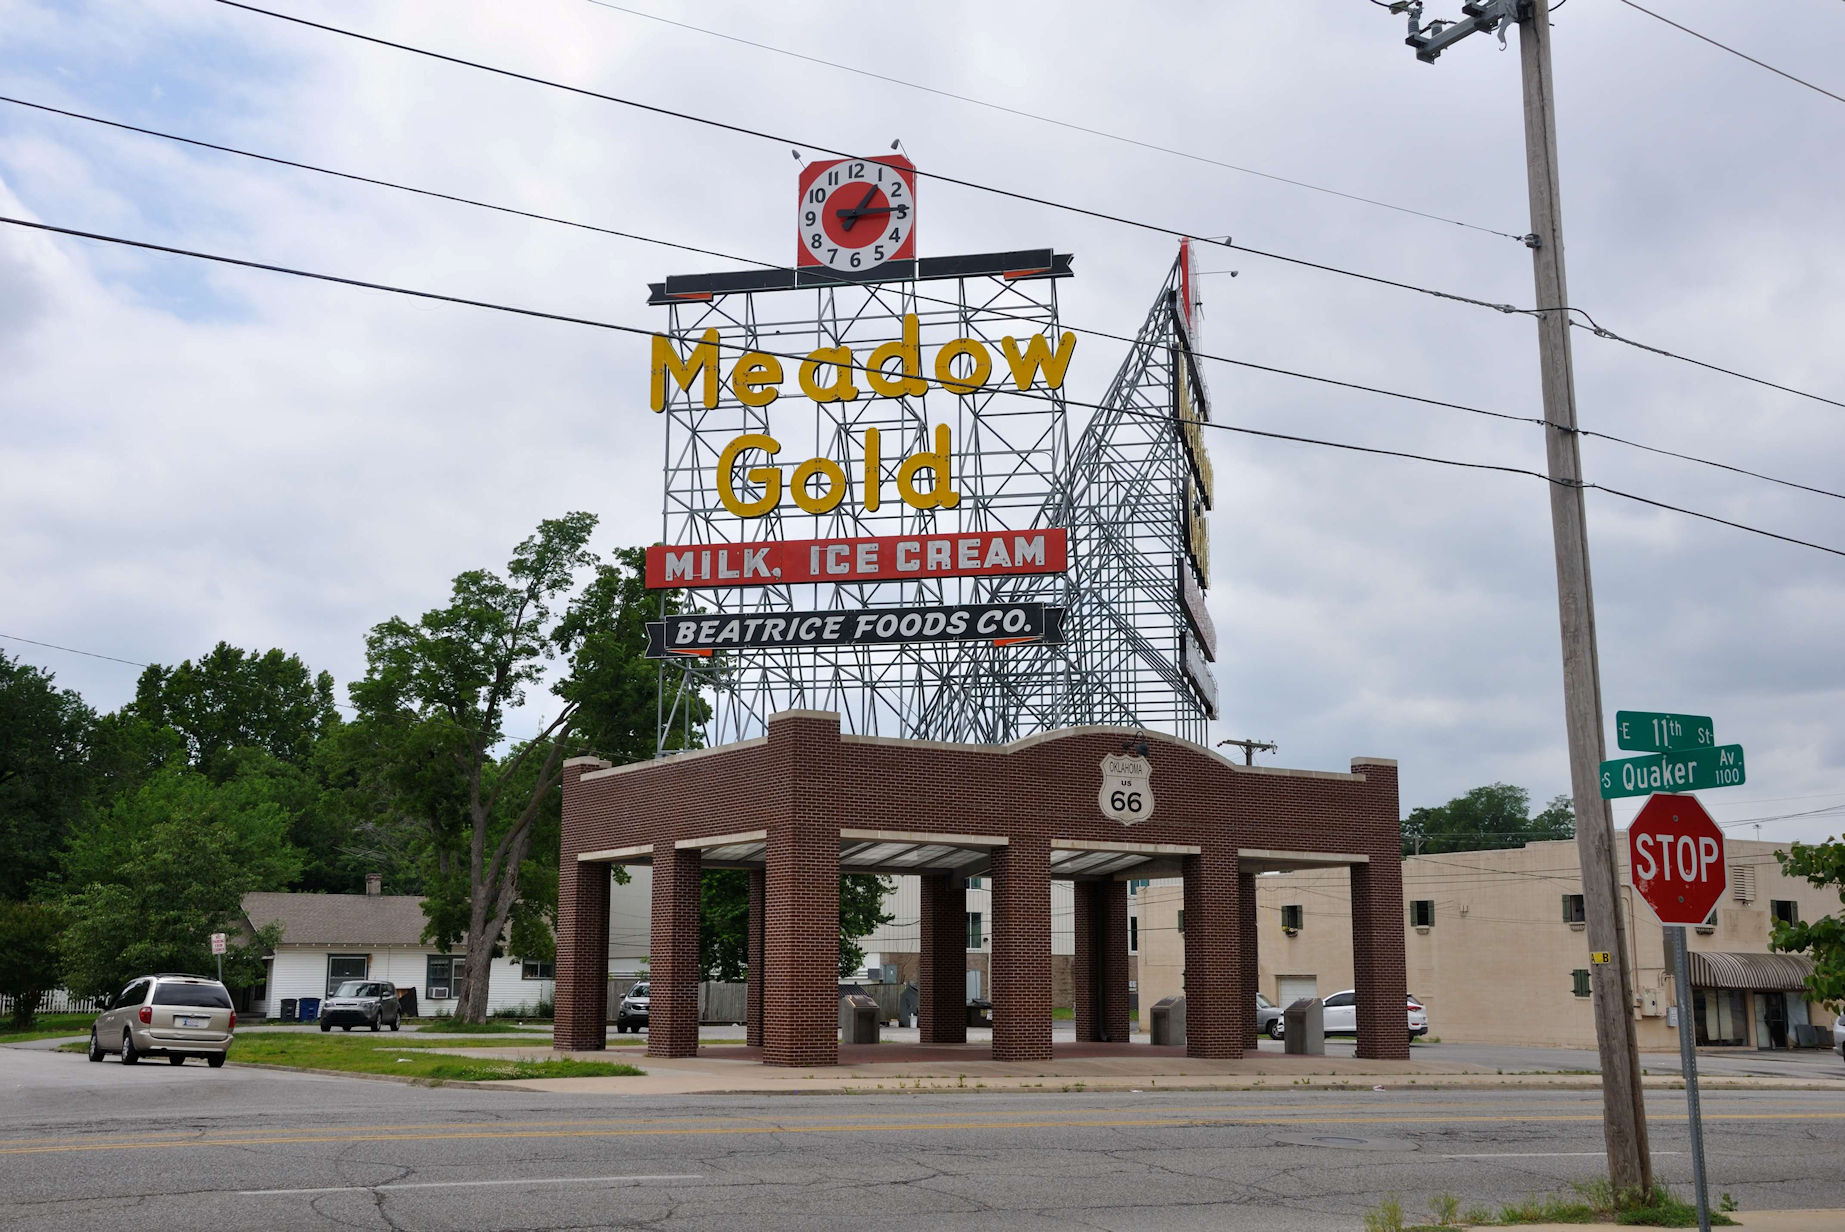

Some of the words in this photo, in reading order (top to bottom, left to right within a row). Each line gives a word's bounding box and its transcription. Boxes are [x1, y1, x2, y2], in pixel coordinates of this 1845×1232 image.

[828, 171, 839, 186] 11
[848, 163, 865, 179] 12
[877, 167, 883, 182] 1
[809, 188, 826, 203] 10
[891, 182, 902, 197] 2
[805, 211, 816, 226] 9
[811, 233, 822, 249] 8
[889, 227, 900, 242] 4
[827, 248, 838, 264] 7
[850, 252, 861, 268] 6
[874, 245, 885, 261] 5
[650, 313, 1077, 413] Meadow
[716, 423, 961, 518] Gold
[810, 543, 880, 575] ICE
[896, 535, 1046, 572] CREAM
[675, 615, 845, 645] BEATRICE
[855, 610, 968, 639] FOODS
[976, 608, 1033, 634] CO.
[1622, 722, 1631, 739] E
[1652, 718, 1682, 747] 11th
[1697, 727, 1711, 744] St
[1109, 761, 1142, 774] OKLAHOMA
[1603, 772, 1612, 788] S
[1622, 759, 1698, 791] Quaker
[1719, 749, 1735, 767] Av
[1715, 768, 1740, 784] 1100
[1110, 790, 1142, 813] 66
[1636, 832, 1719, 883] STOP
